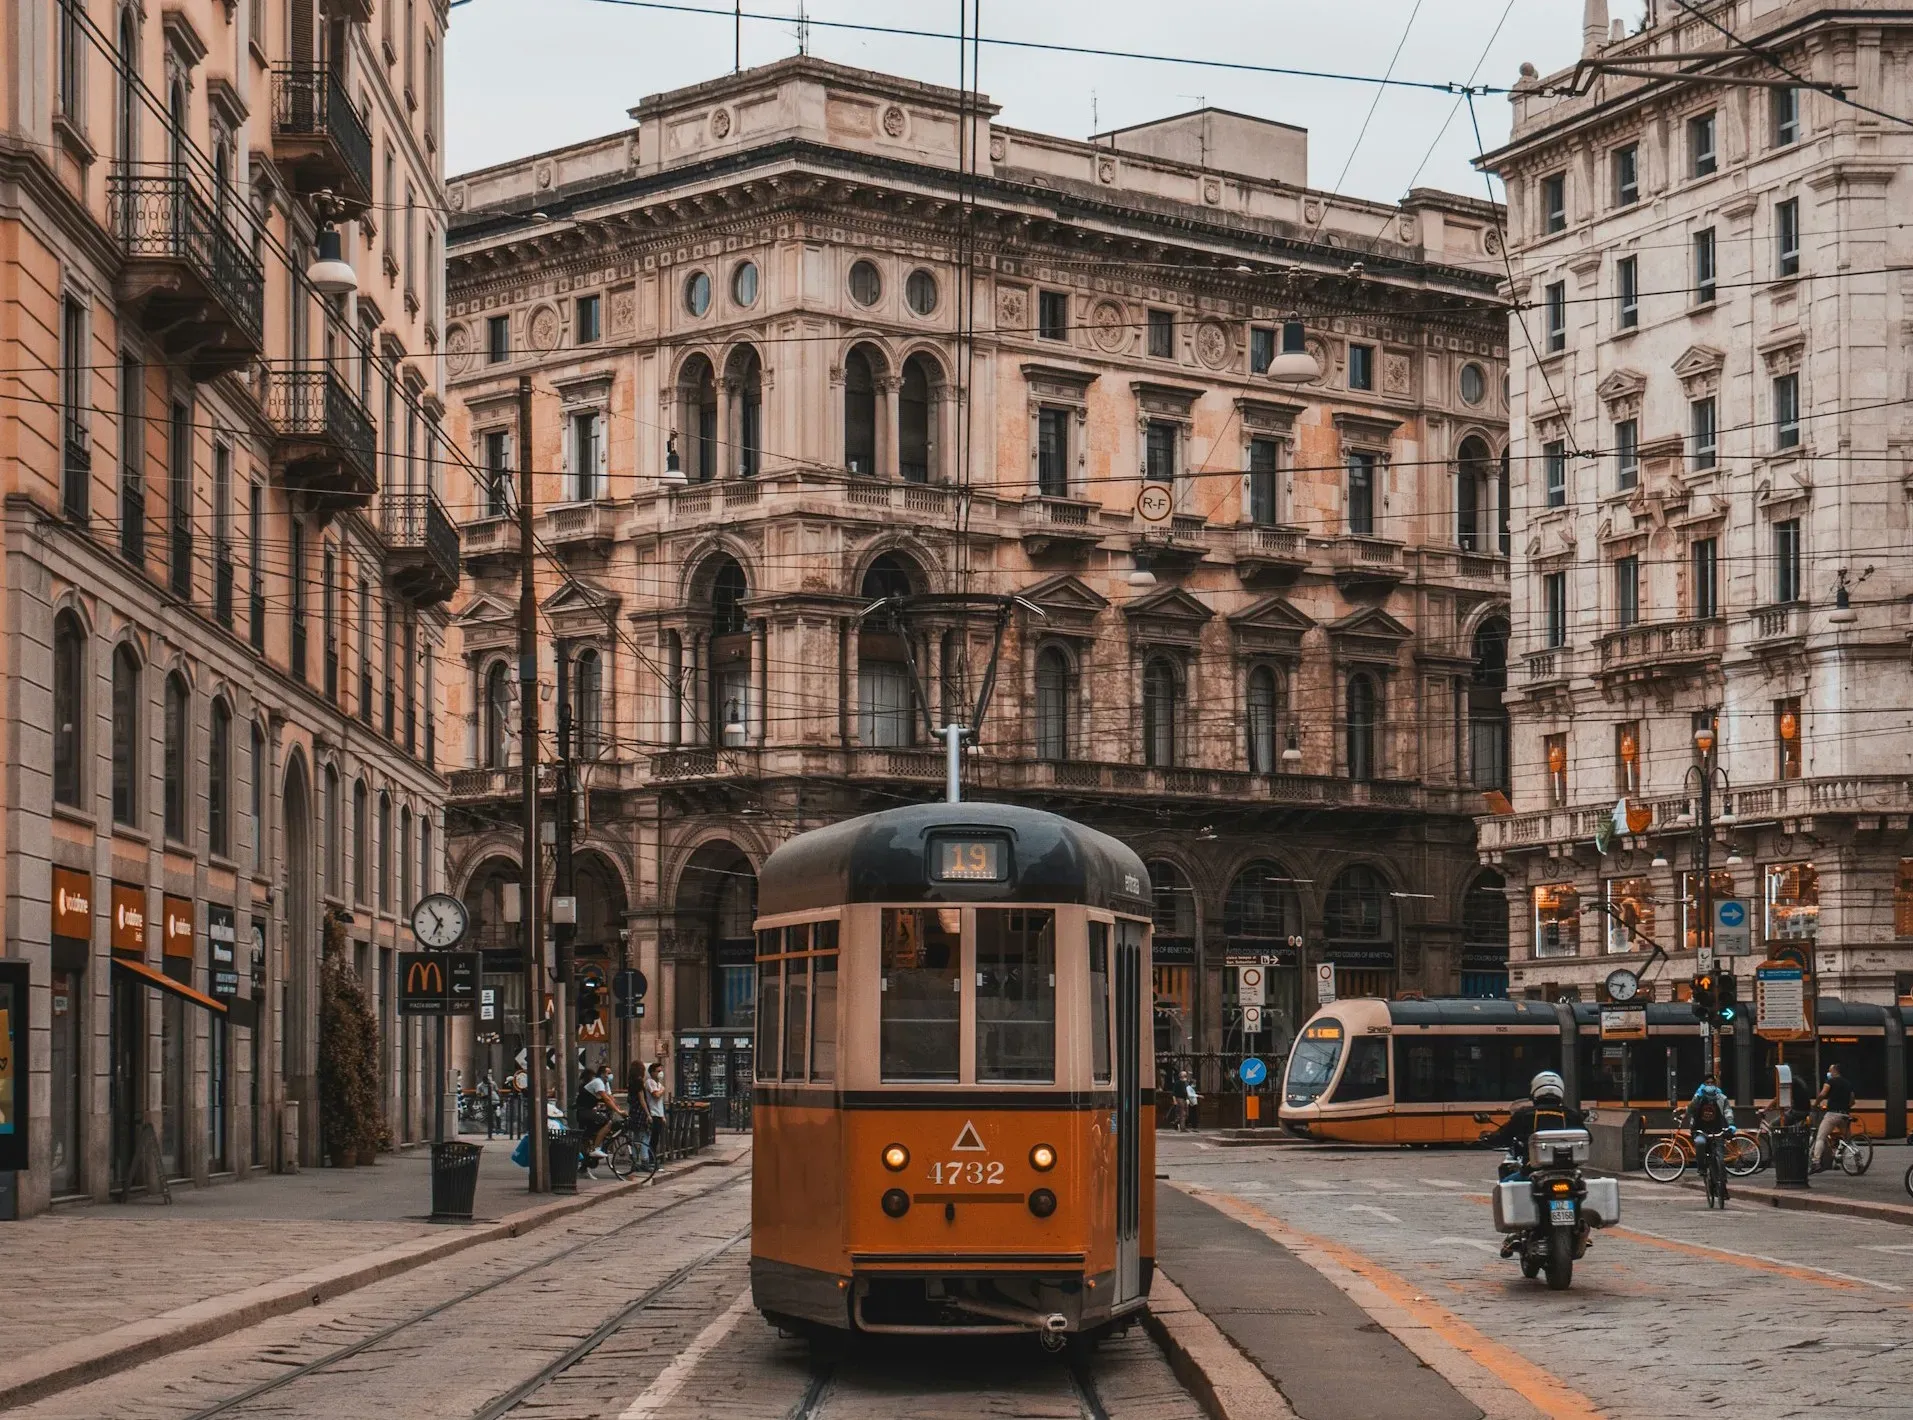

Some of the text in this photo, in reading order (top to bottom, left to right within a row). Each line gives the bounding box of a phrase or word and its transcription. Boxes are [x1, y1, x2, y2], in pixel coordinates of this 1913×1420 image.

[1142, 497, 1167, 510] R-F
[951, 843, 987, 871] 19
[66, 893, 89, 914] vodafone
[125, 907, 143, 928] vodafone
[175, 917, 191, 936] vodafone
[927, 1161, 1005, 1185] 4732
